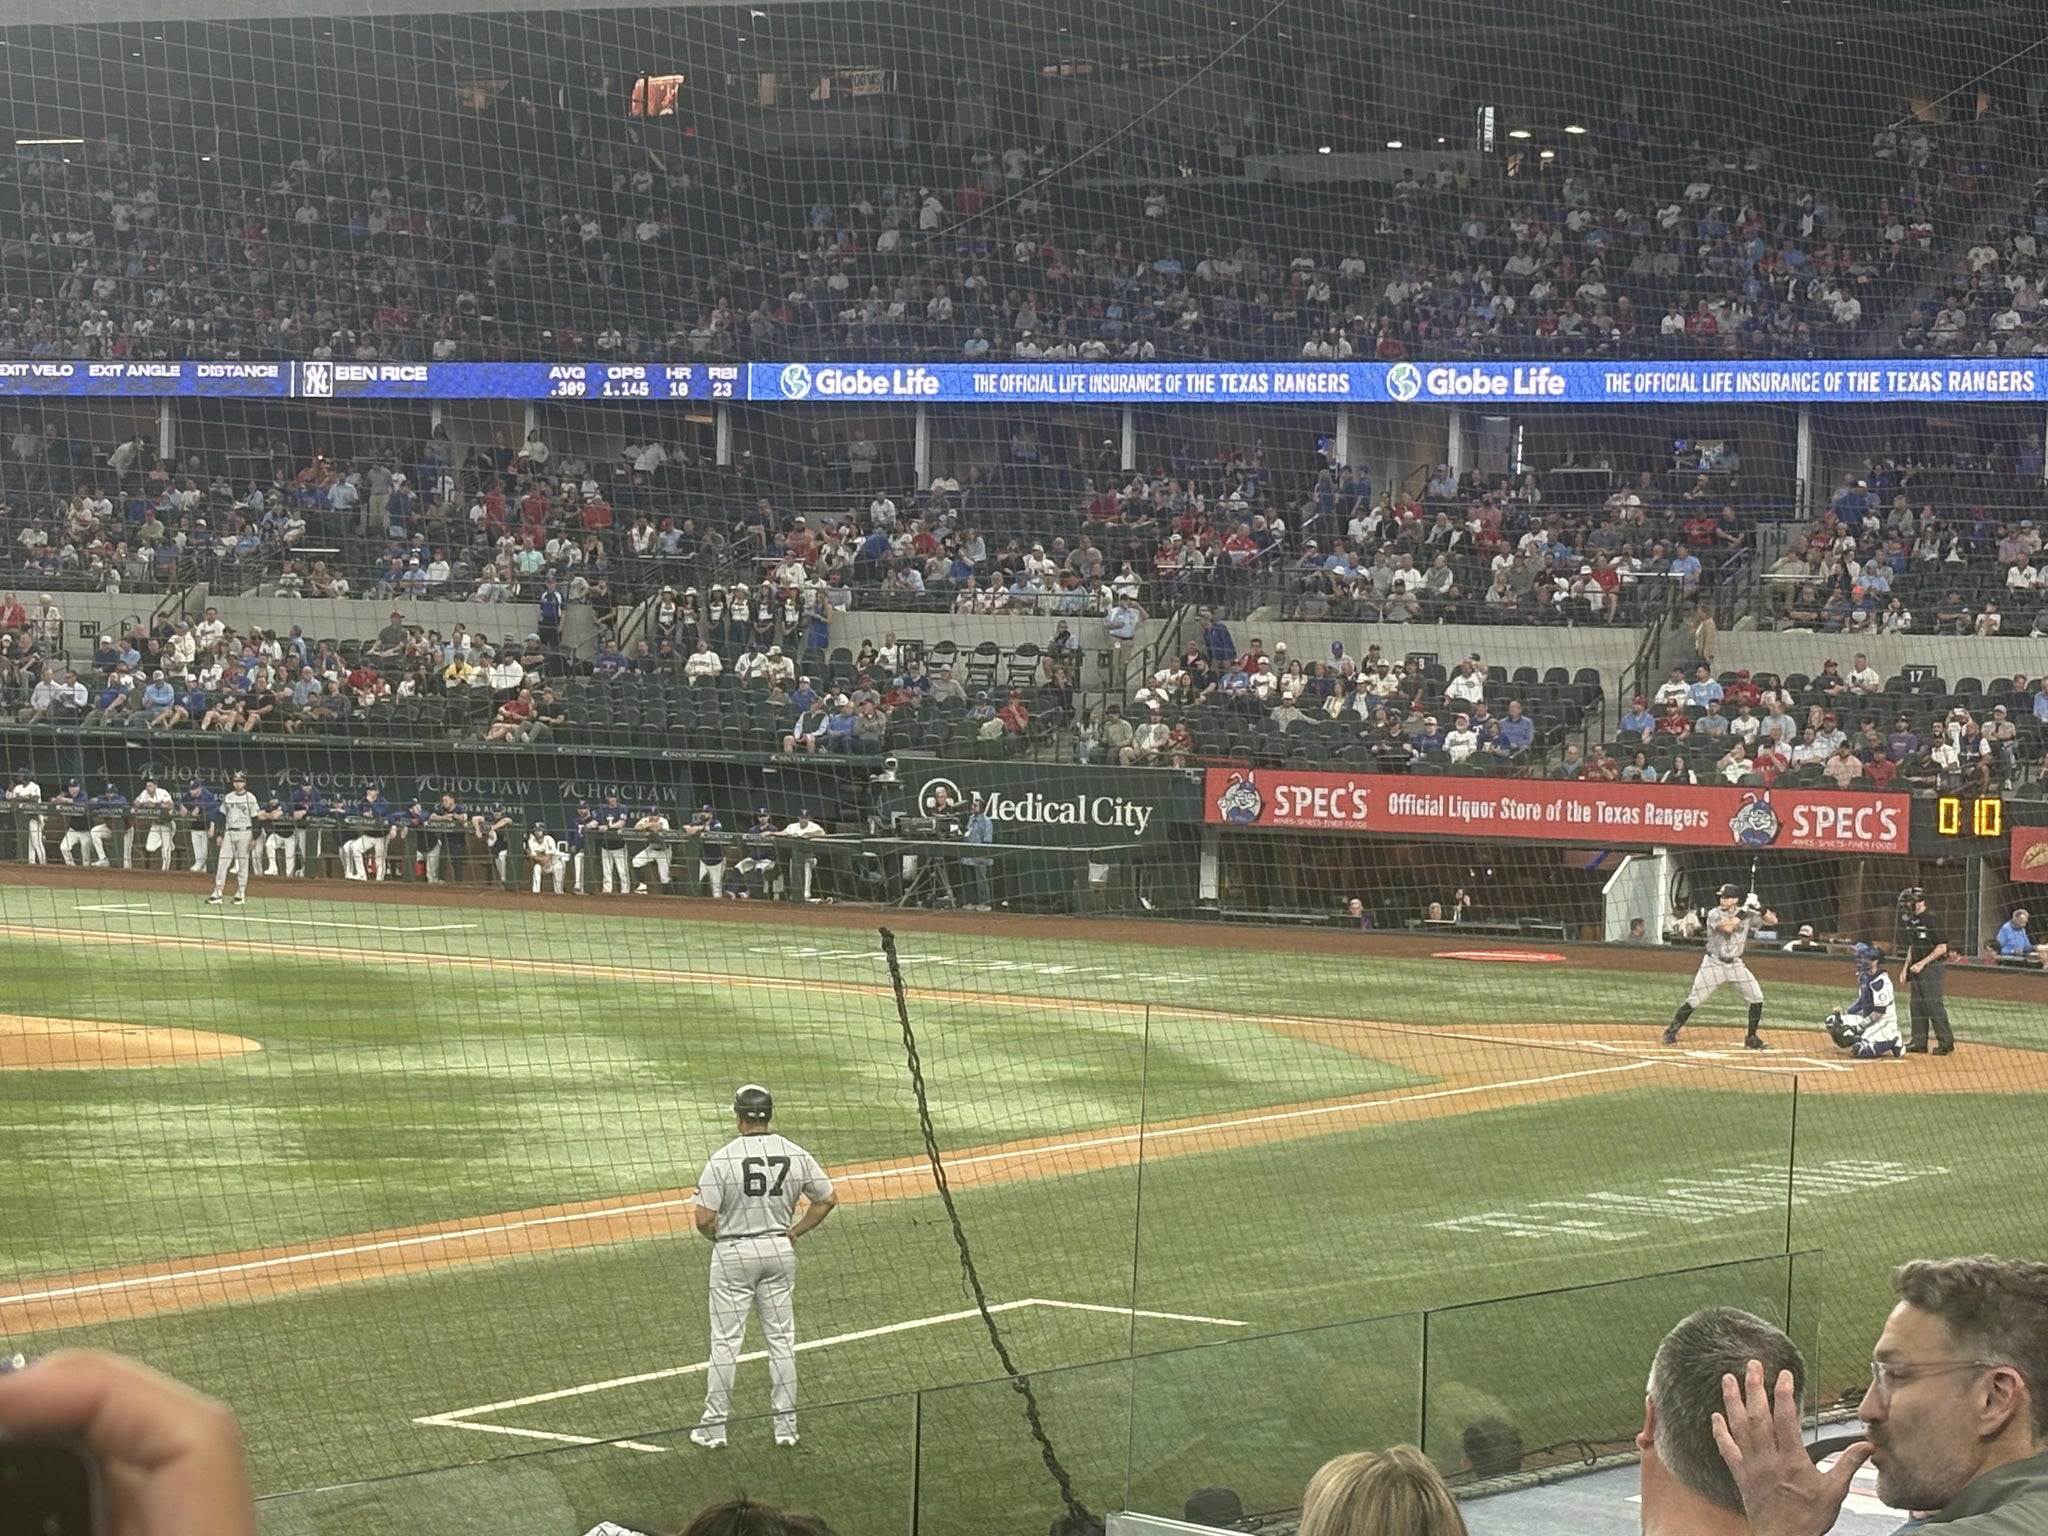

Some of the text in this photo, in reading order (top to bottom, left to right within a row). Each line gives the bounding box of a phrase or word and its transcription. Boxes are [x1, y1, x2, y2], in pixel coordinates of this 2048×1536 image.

[32, 365, 74, 377] VELO
[89, 365, 124, 378] EXIT
[127, 365, 181, 378] ANGLE
[197, 365, 279, 378] DISTANCE
[336, 366, 428, 381] BEN RICE
[549, 367, 738, 380] AVG OPS HR RBI
[815, 368, 939, 395] Globe Life
[973, 373, 1349, 393] THE OFFICIAL LIFE INSURANCE OF THE TEXAS RANGERS
[1427, 367, 1565, 395] Globe Life
[1605, 371, 2035, 394] THE OFFICIAL LIFE INSURANCE OF THE TEXAS RANGERS
[669, 382, 688, 397] 10
[712, 382, 733, 397] 23
[1909, 670, 1923, 682] 17
[427, 776, 531, 796] CHOCTAW
[1273, 781, 1368, 820] SPEC'S
[1388, 792, 1709, 828] Official Liquor Store of the Texas Rangers
[970, 790, 1153, 836] Medical City
[1792, 800, 1898, 841] SPEC'S
[741, 1156, 791, 1197] 67
